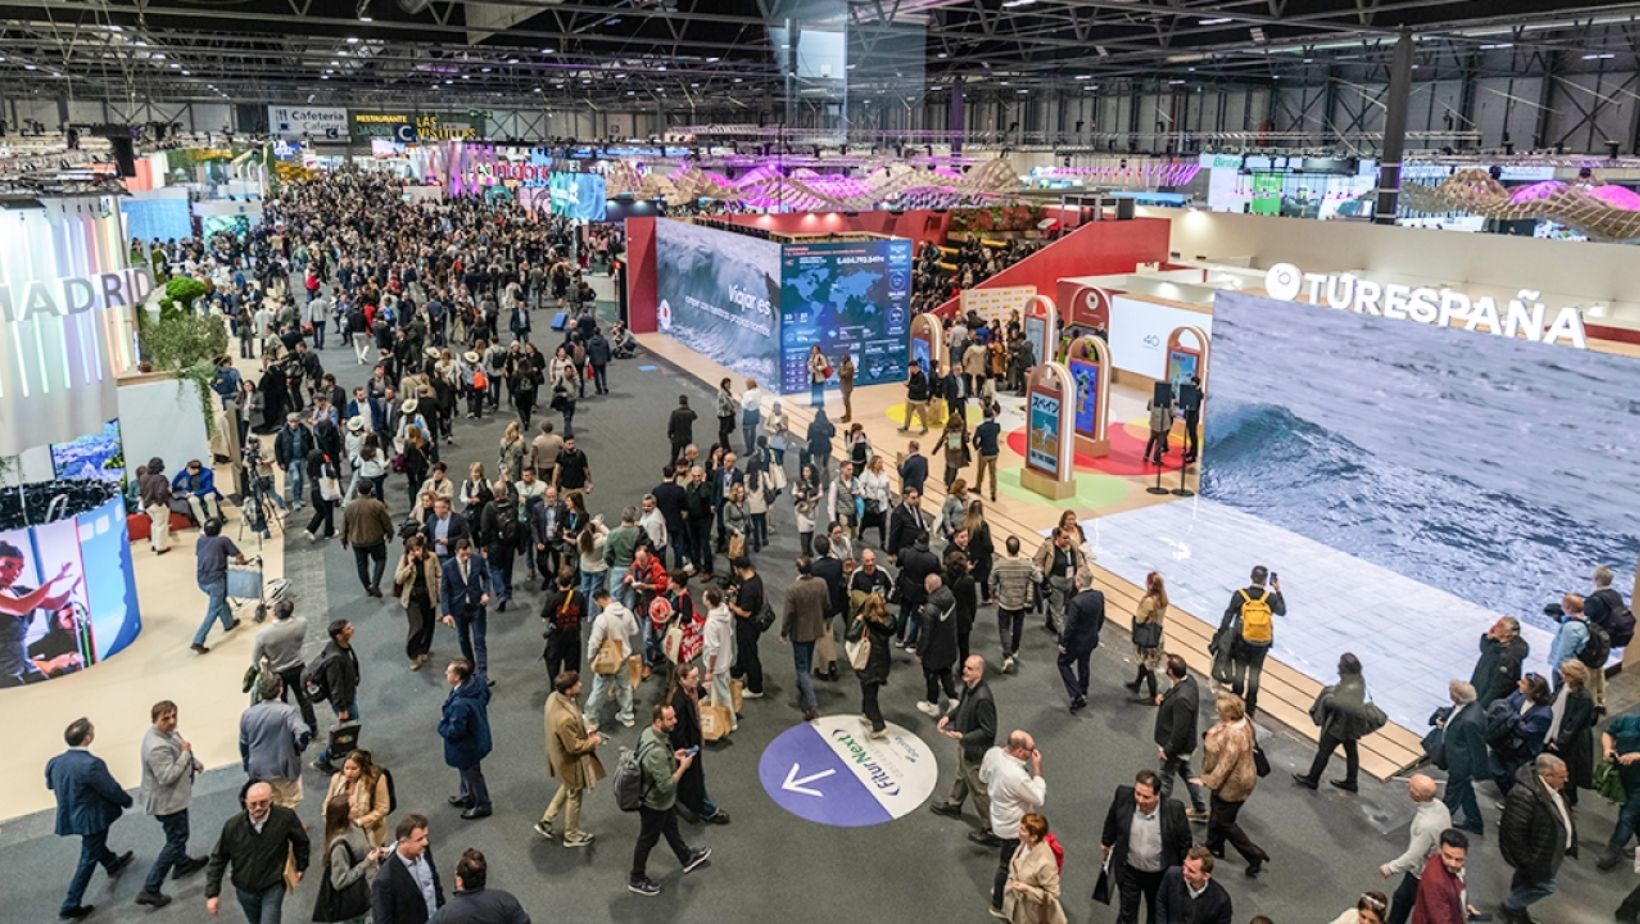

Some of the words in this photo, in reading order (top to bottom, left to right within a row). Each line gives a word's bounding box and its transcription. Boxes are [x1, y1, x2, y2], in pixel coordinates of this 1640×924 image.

[416, 116, 437, 128] LAS
[398, 125, 412, 141] C
[729, 284, 757, 312] Viajar
[757, 298, 771, 316] es
